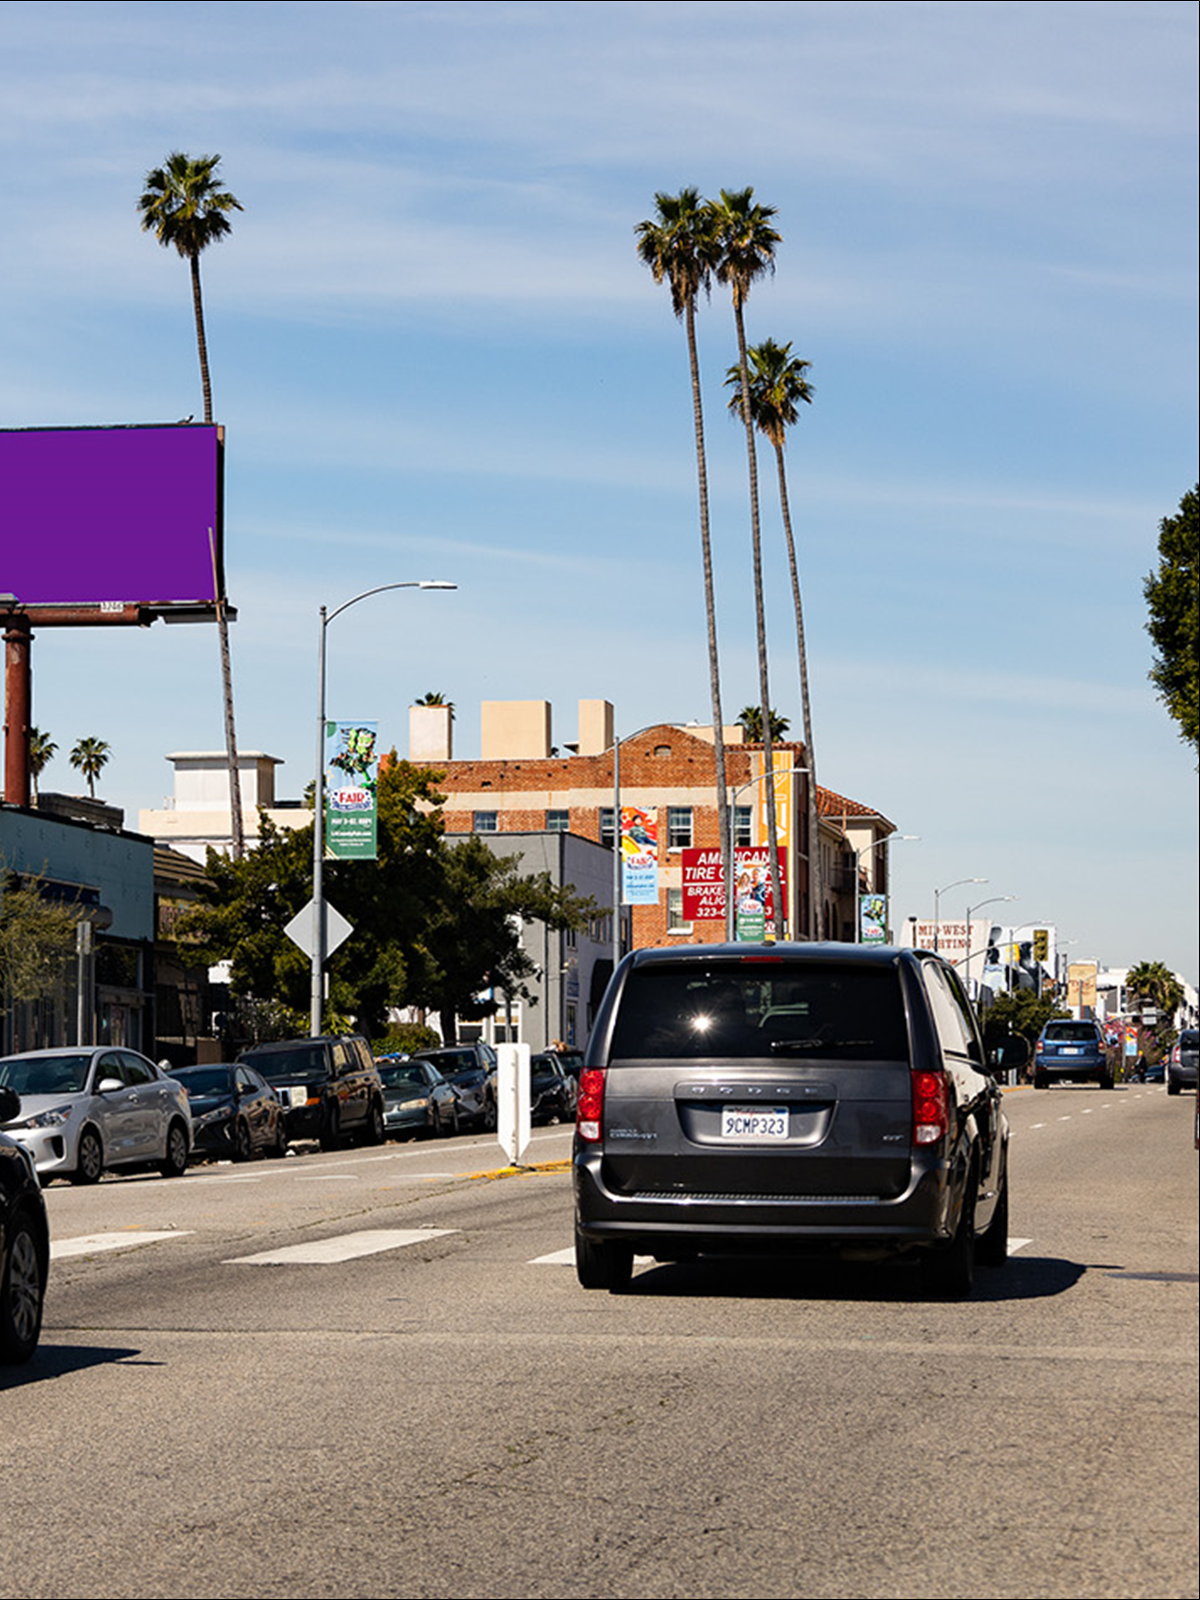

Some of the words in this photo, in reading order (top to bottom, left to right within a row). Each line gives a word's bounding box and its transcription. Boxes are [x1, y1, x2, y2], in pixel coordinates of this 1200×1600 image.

[339, 792, 365, 804] FAIR
[685, 866, 716, 880] TIRE
[725, 1117, 785, 1135] 9CMP323
